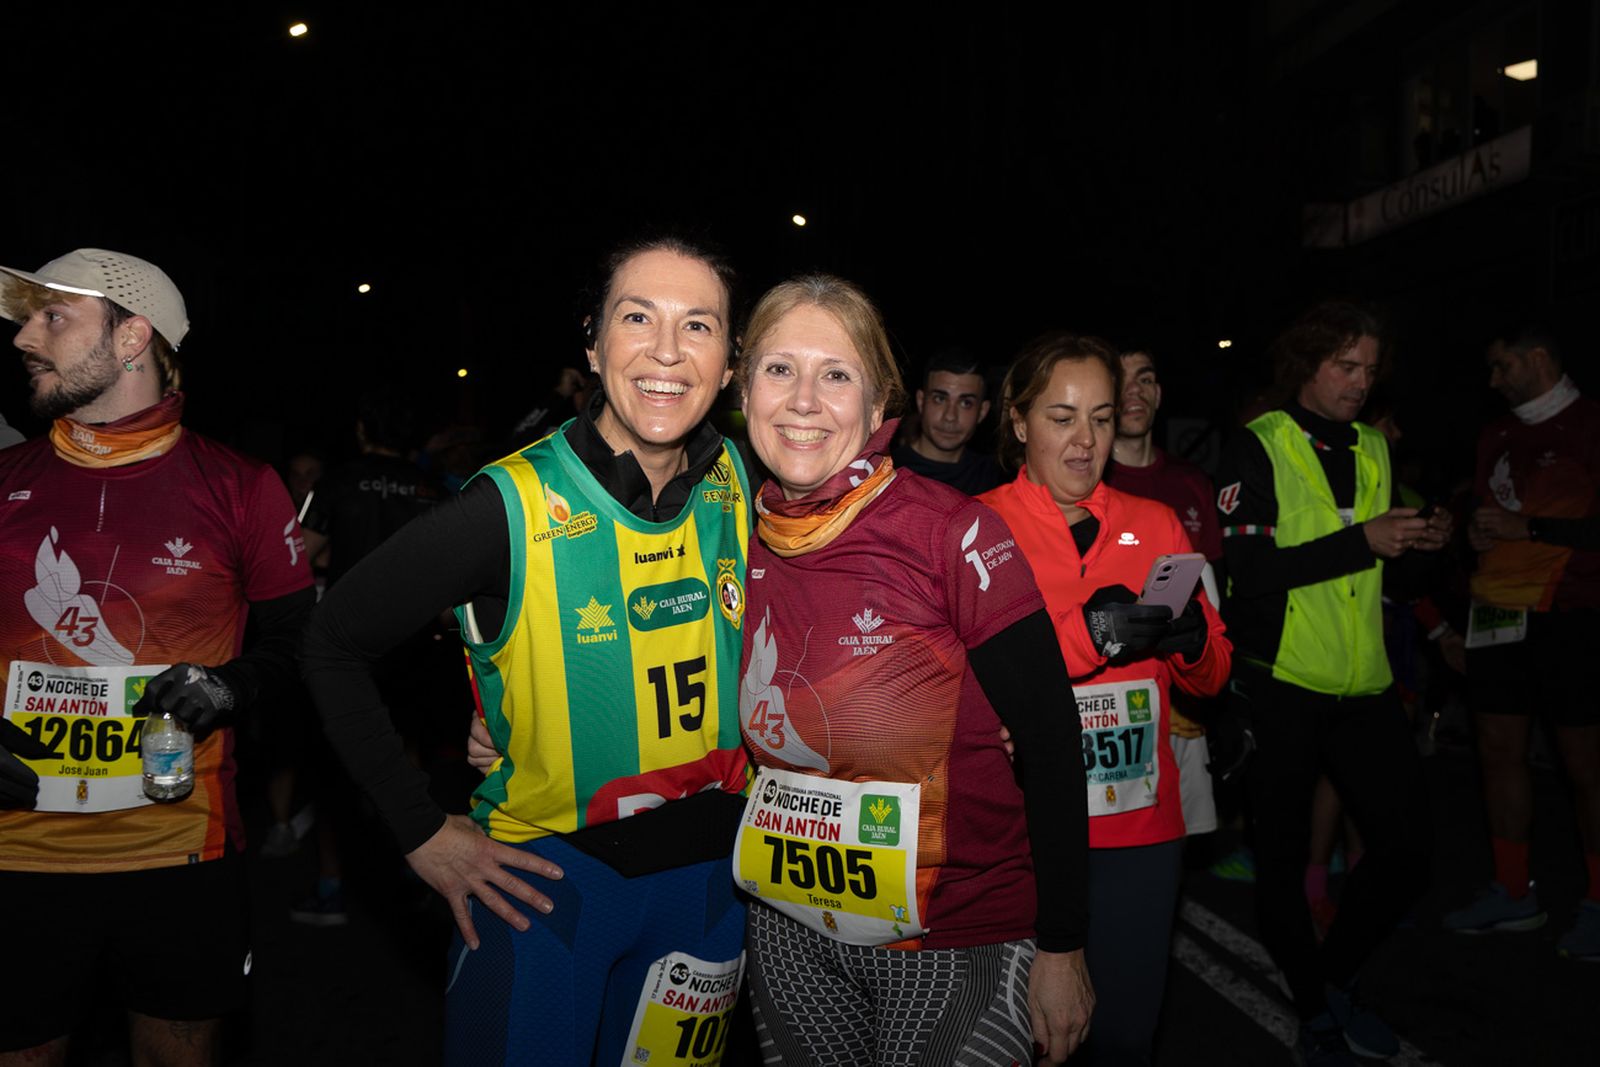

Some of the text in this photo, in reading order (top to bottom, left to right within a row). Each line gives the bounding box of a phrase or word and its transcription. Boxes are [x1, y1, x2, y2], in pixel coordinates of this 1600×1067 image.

[533, 526, 564, 542] GREEN
[564, 515, 597, 532] ENERGY
[634, 546, 674, 564] luanvi
[659, 591, 707, 609] CAJA RURAL
[55, 606, 98, 647] 43
[576, 629, 618, 644] luanvi
[838, 634, 896, 646] CAJA RURAL
[45, 680, 109, 698] NOCHE DE
[647, 655, 707, 739] 15
[25, 696, 108, 716] SAN ANTÓN
[1102, 697, 1116, 711] DE
[749, 700, 785, 750] 43
[1083, 711, 1119, 729] NTÓN
[25, 716, 142, 762] 12664
[58, 764, 108, 776] Jose Juan
[774, 792, 819, 814] NOCHE
[821, 800, 843, 817] DE
[754, 808, 841, 842] SAN ANTÓN
[764, 835, 877, 900] 7505
[807, 893, 842, 908] Teresa
[688, 974, 733, 994] NOCHE
[662, 989, 699, 1012] SAN
